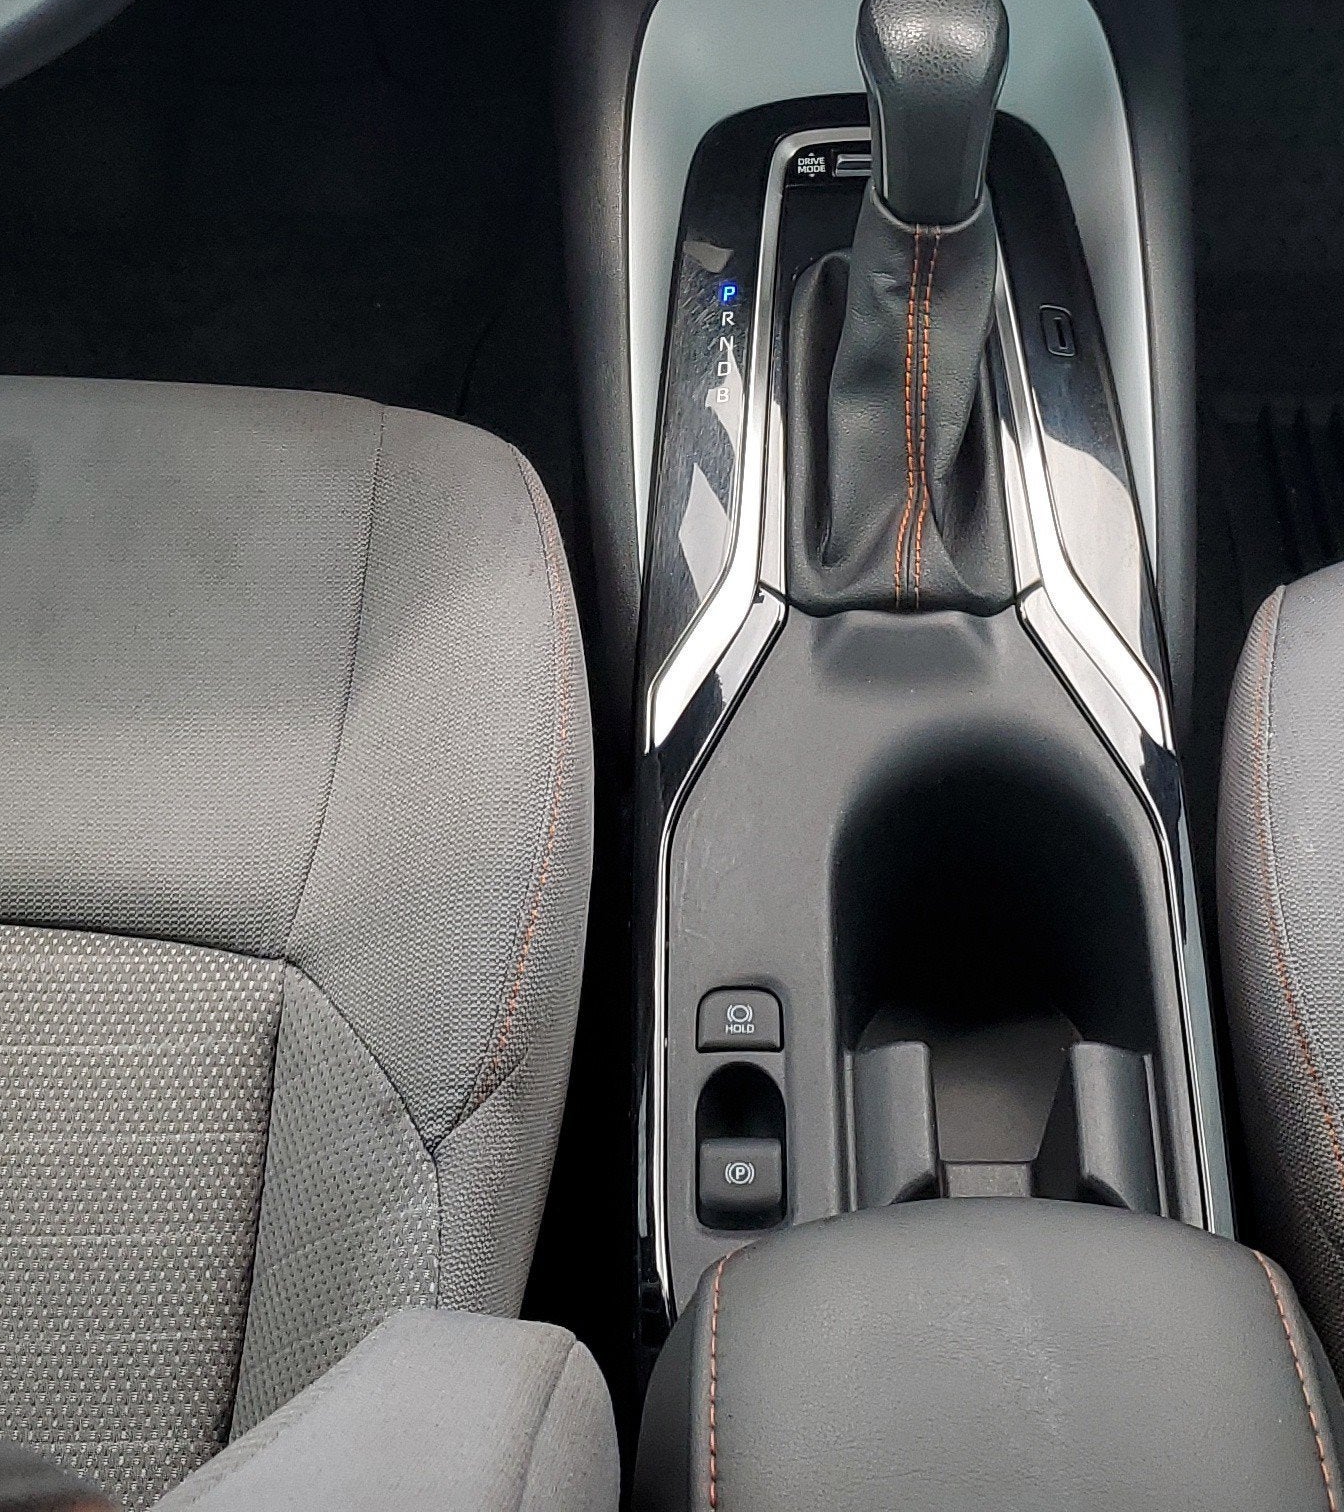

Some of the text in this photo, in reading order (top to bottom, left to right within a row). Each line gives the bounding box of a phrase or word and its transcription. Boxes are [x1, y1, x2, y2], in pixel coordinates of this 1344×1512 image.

[797, 157, 826, 166] DRIVE
[797, 165, 826, 174] MODE
[723, 286, 736, 301] P
[721, 311, 735, 326] R
[719, 335, 734, 351] N
[717, 361, 732, 376] D
[716, 387, 731, 402] B
[725, 1023, 755, 1034] HOLD
